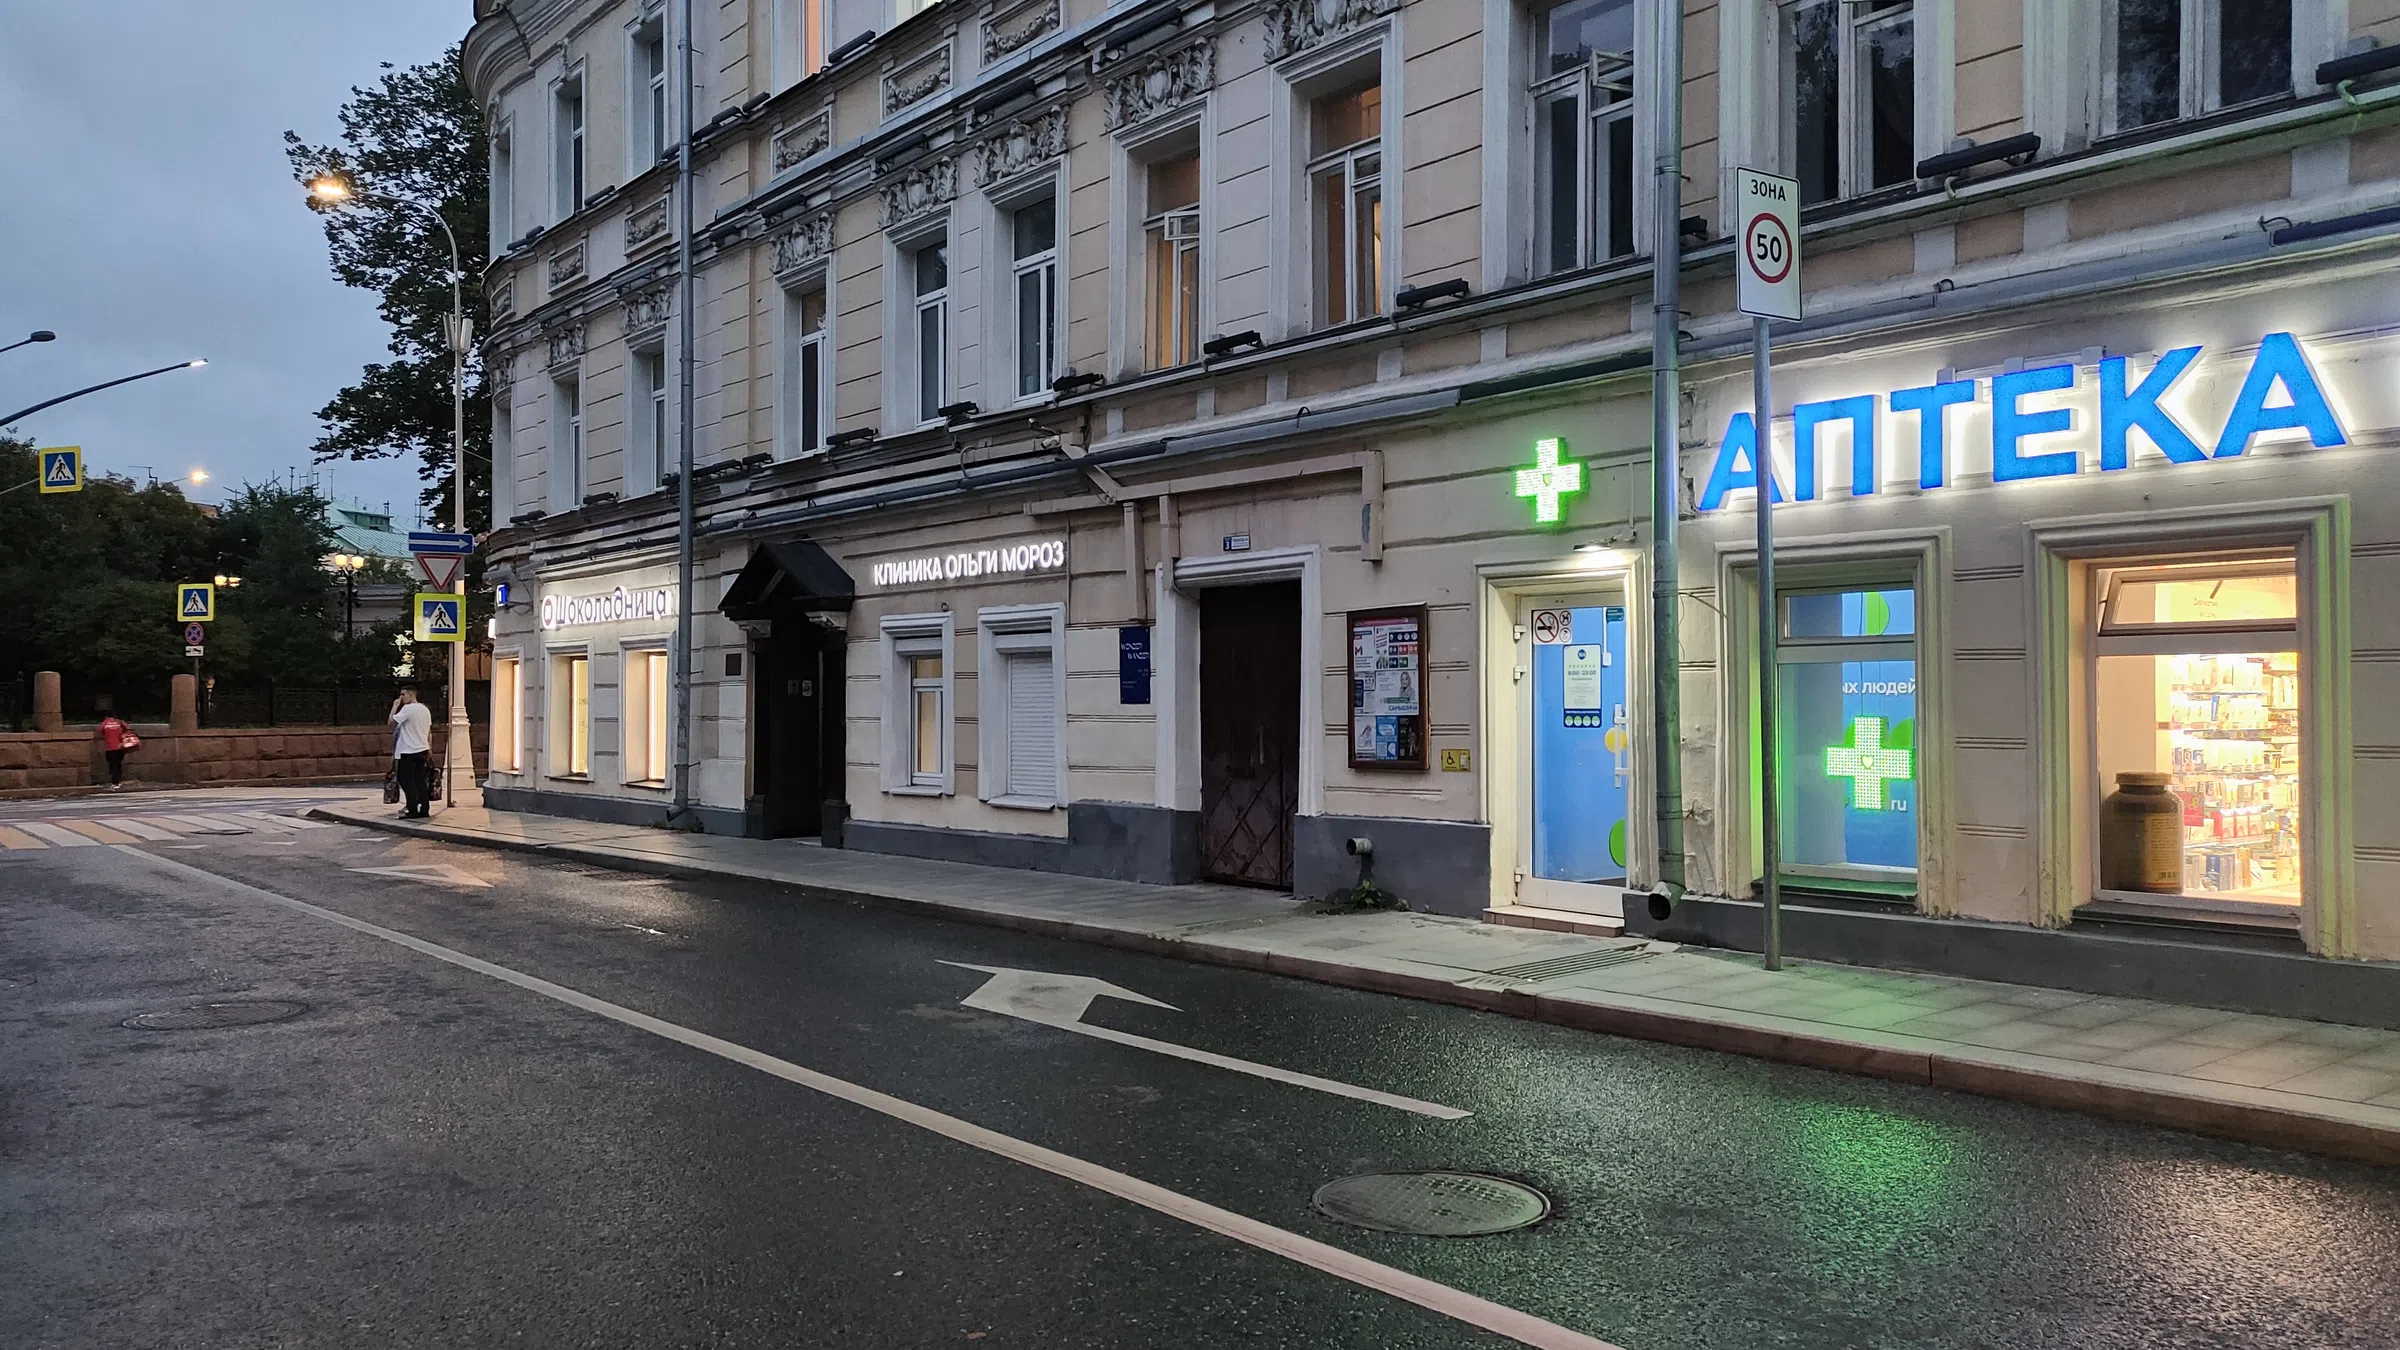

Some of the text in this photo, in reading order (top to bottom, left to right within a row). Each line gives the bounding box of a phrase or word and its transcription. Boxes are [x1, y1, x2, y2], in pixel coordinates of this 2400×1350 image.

[1751, 179, 1786, 201] ЗОНА
[1757, 233, 1782, 262] 50
[1700, 331, 2350, 511] АПТЕКА
[1225, 541, 1230, 550] 3
[874, 540, 1065, 586] КЛИНИКА ОЛЬГИ МОРОЗ
[1862, 678, 1915, 696] людей
